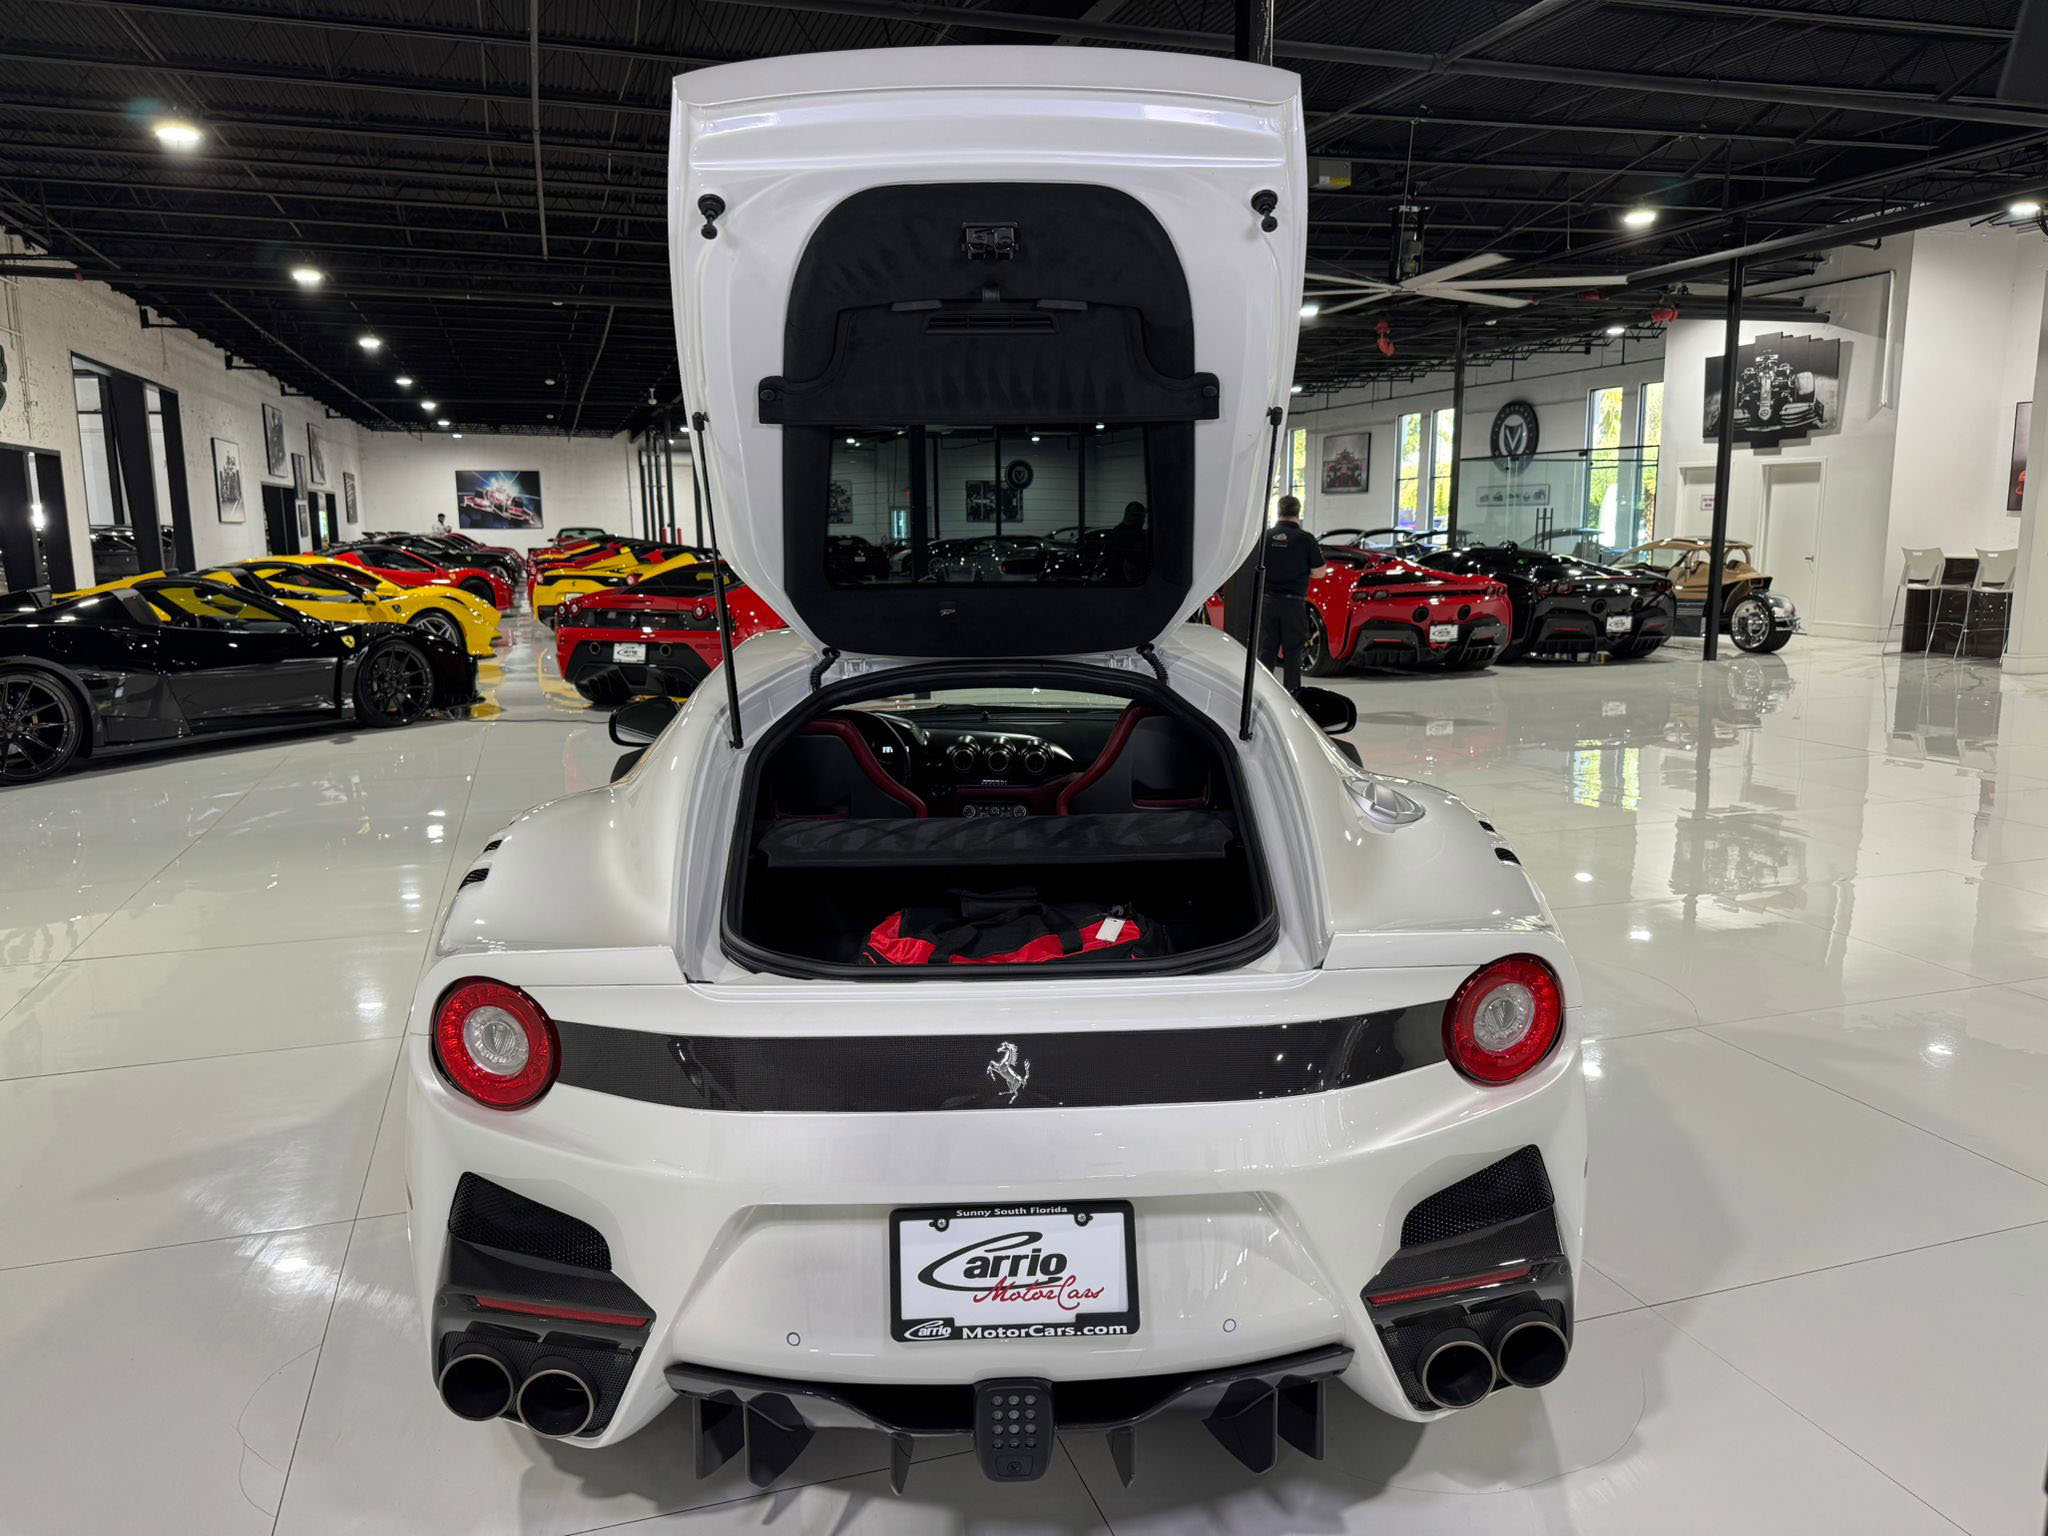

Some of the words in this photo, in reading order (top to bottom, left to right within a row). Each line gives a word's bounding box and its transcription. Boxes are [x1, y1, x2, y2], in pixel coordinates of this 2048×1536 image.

[956, 1209, 991, 1217] Sunny
[994, 1207, 1027, 1216] South
[1030, 1205, 1068, 1214] Florida
[917, 1231, 1068, 1292] Carrio
[903, 1320, 952, 1340] Carrio
[962, 1324, 1128, 1339] MotorCars.com
